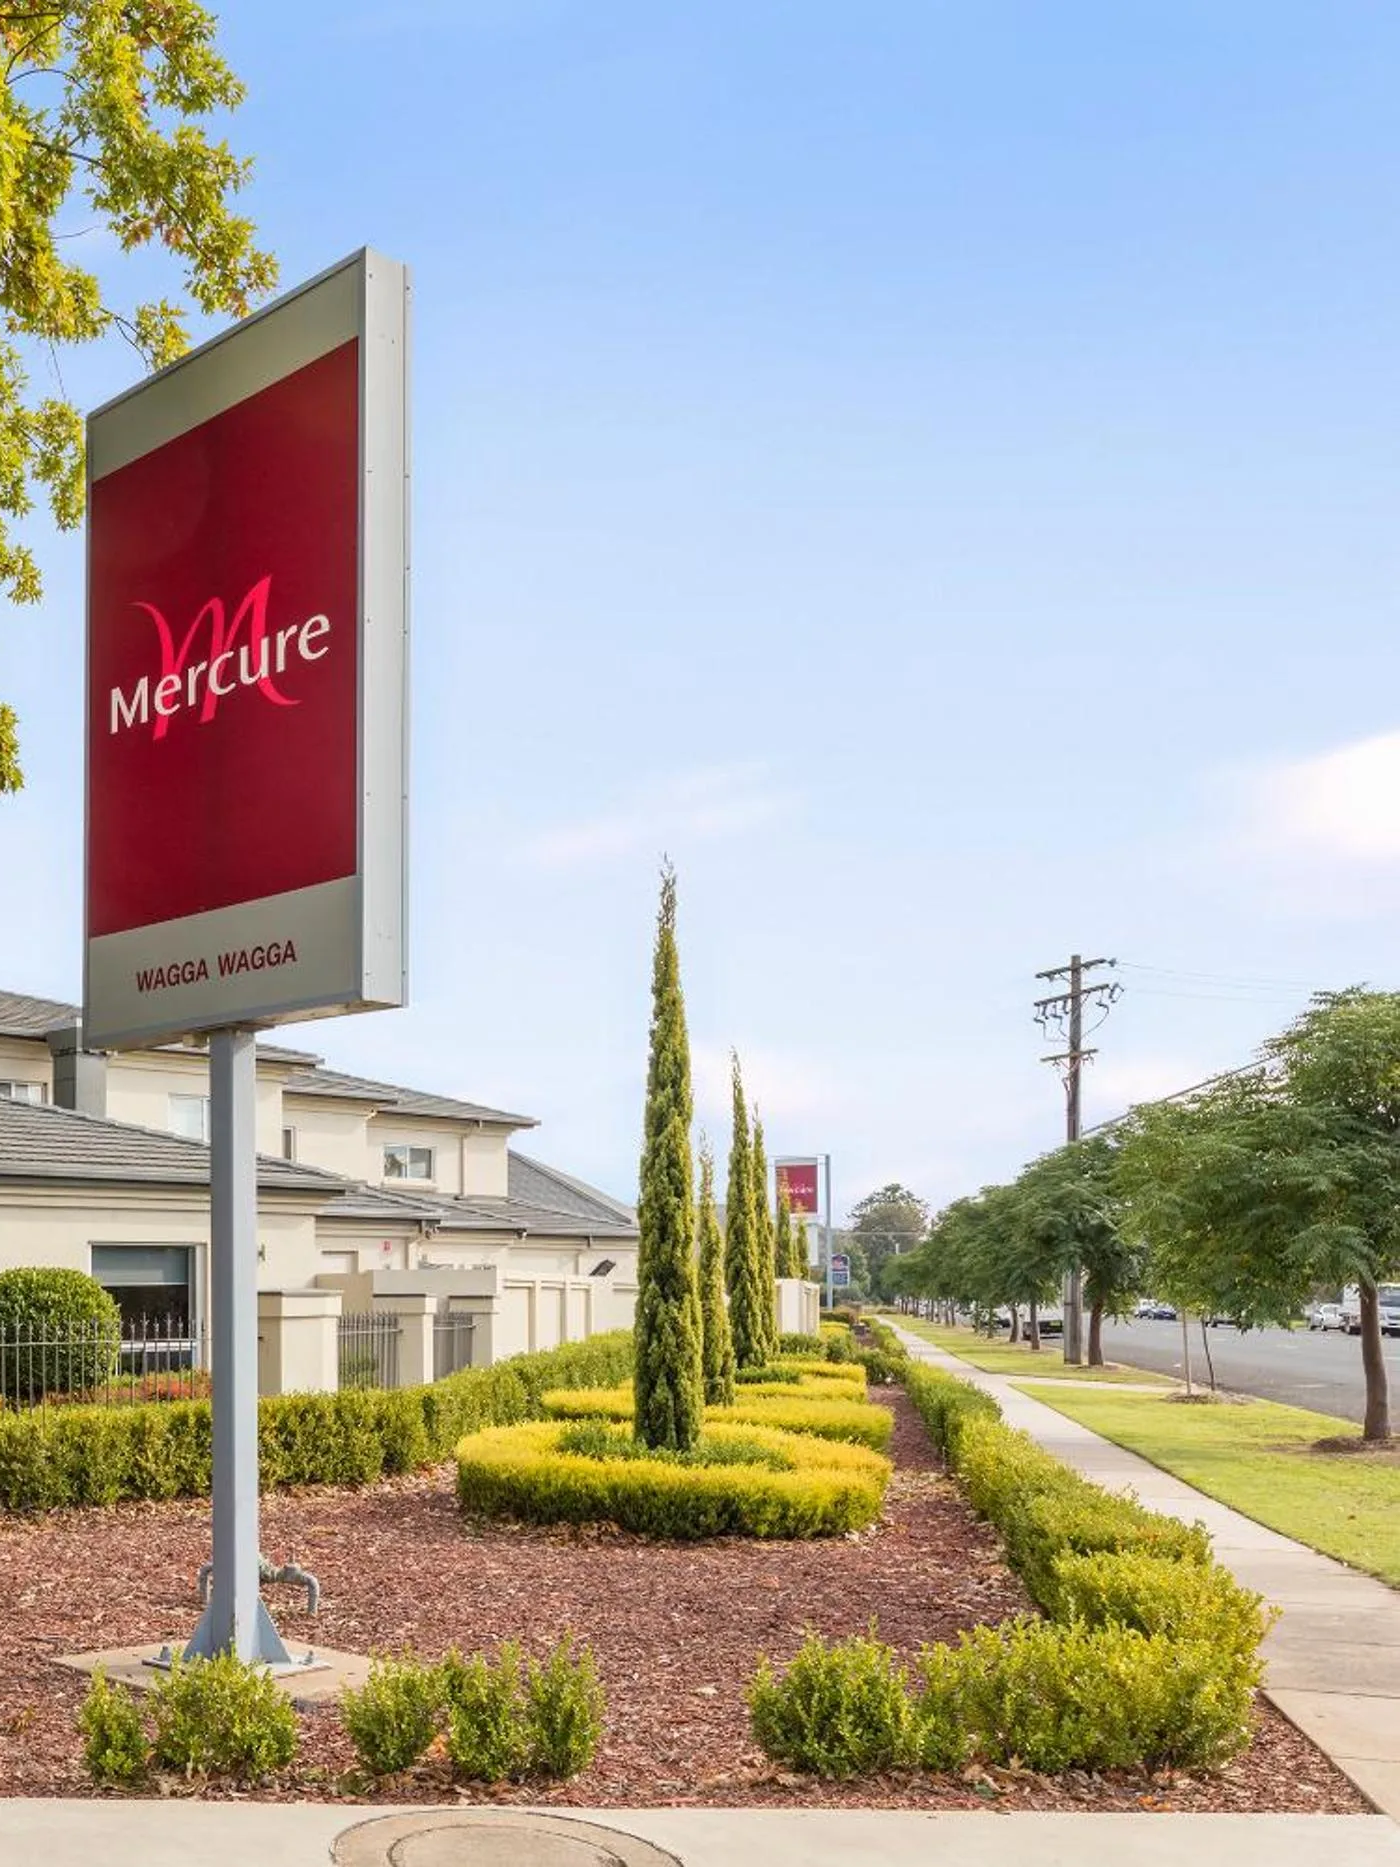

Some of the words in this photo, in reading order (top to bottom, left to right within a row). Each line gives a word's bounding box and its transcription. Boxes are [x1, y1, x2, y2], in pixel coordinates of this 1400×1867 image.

[110, 613, 331, 735] Mercure
[136, 958, 209, 992] WAGGA
[218, 939, 298, 977] WAGGA
